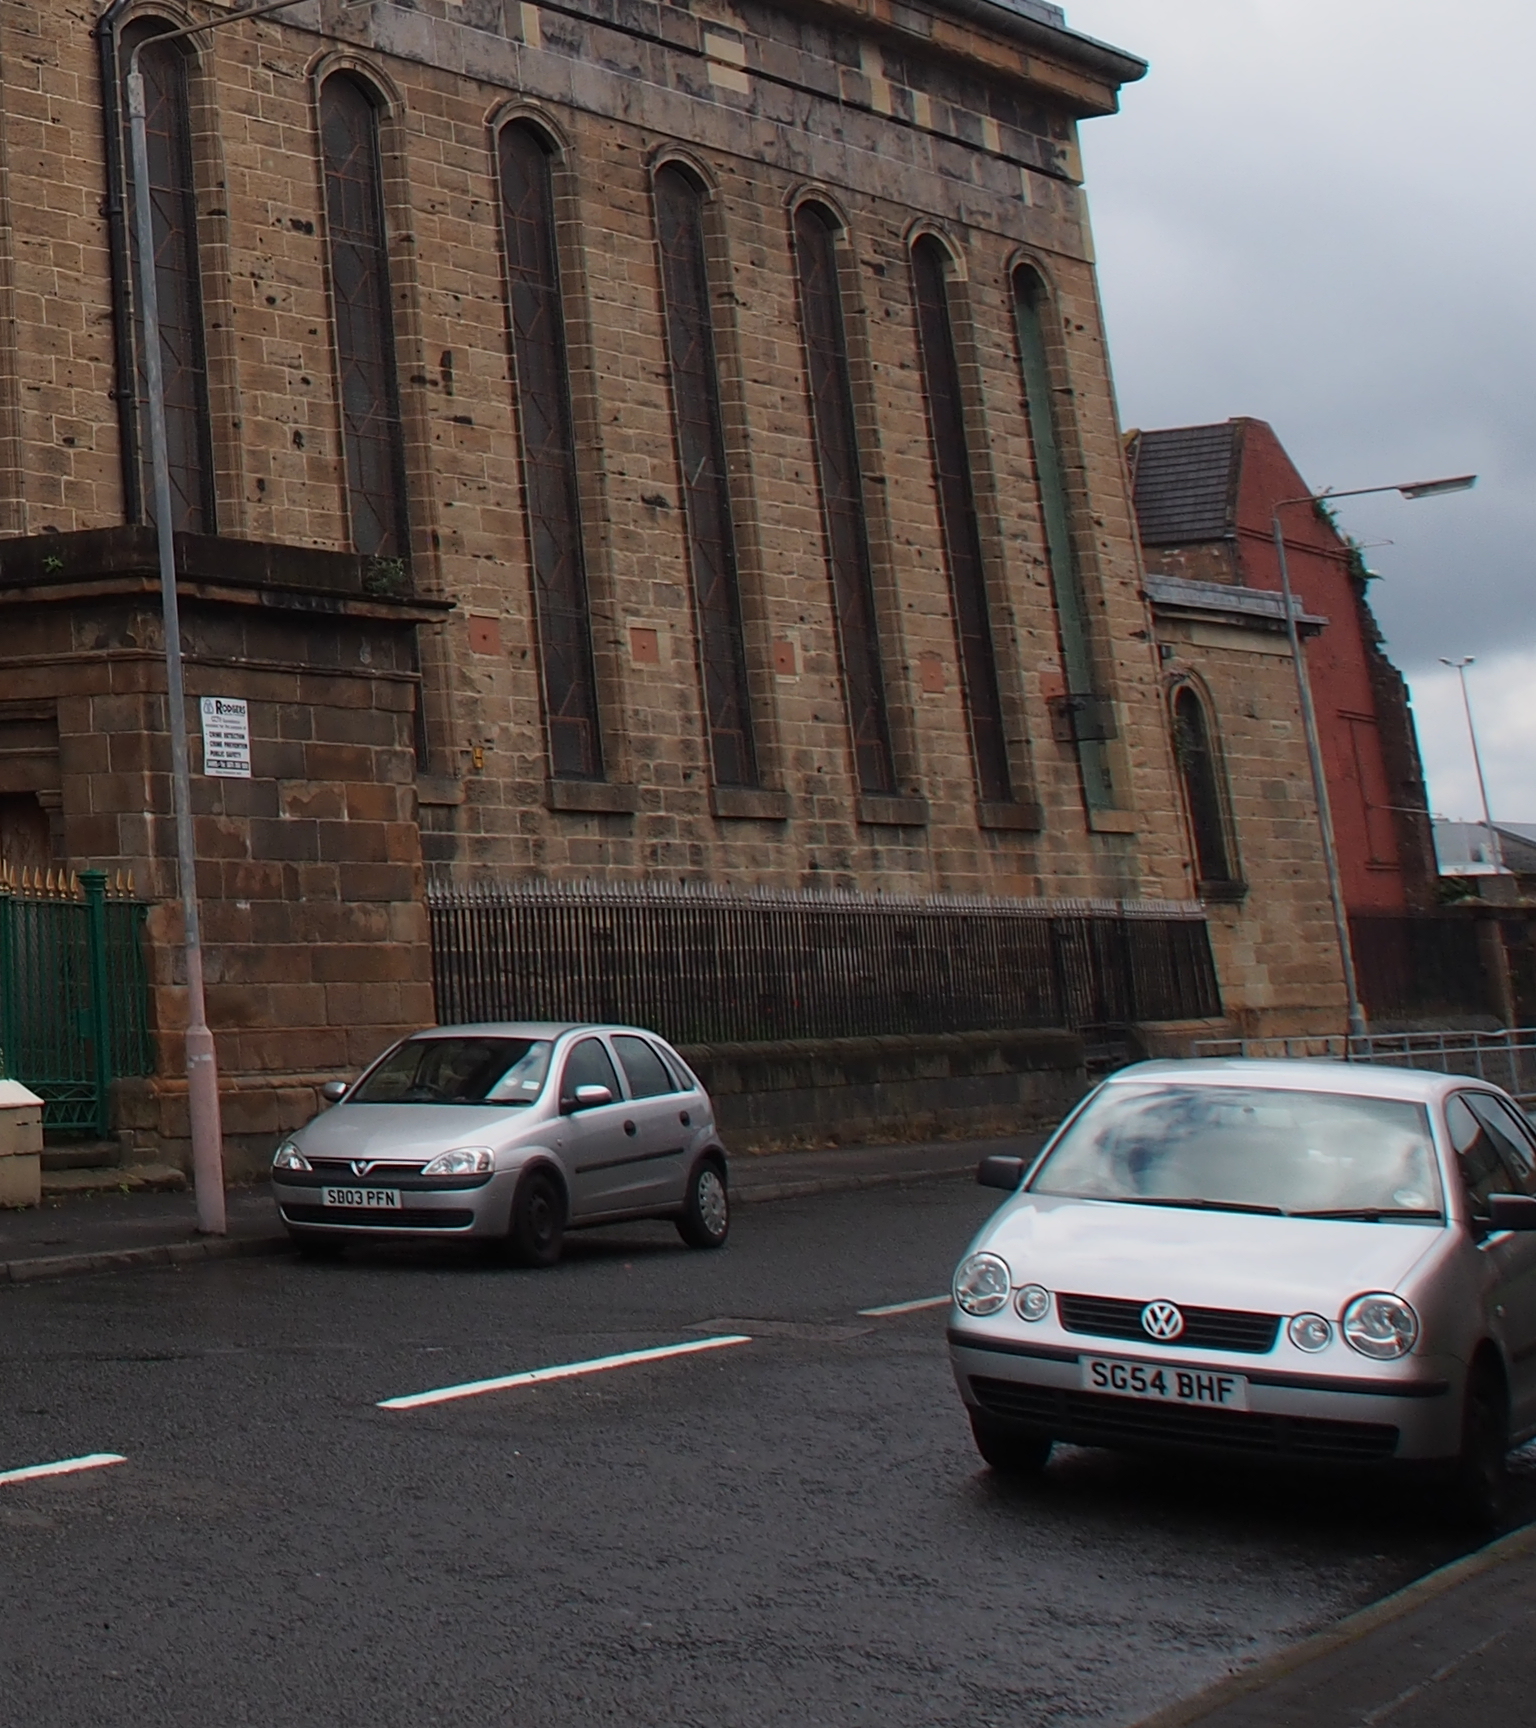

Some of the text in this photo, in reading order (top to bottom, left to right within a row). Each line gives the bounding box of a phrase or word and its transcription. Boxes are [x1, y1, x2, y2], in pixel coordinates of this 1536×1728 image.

[215, 700, 245, 714] RODGERS
[328, 1189, 395, 1206] SB03 PFN
[1091, 1361, 1234, 1403] SG54 BHF
